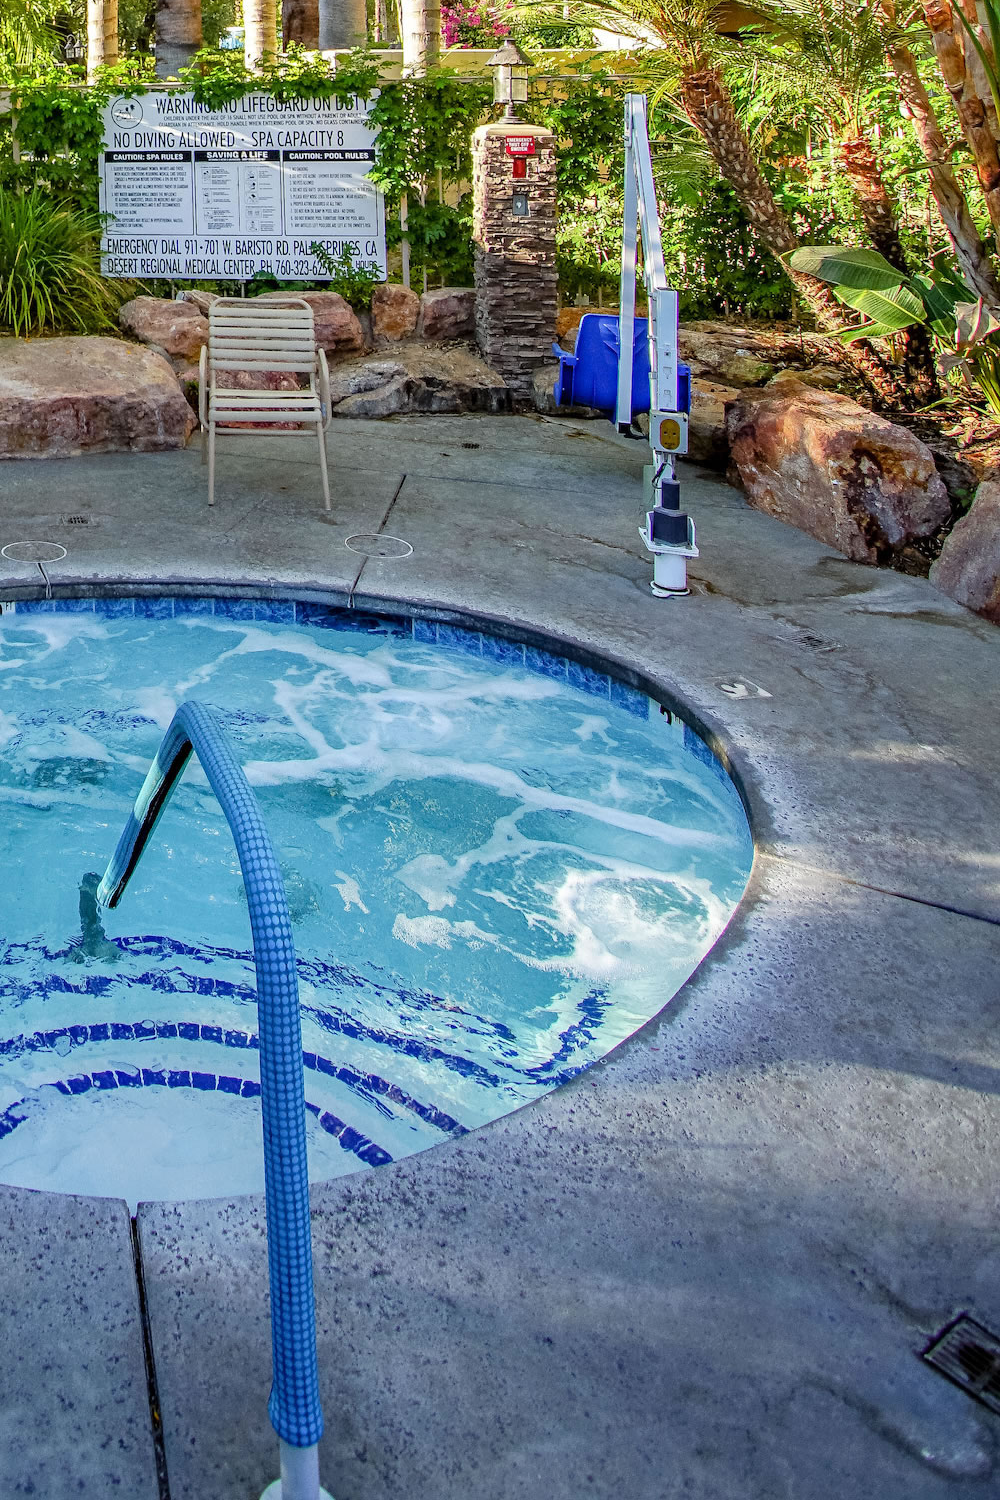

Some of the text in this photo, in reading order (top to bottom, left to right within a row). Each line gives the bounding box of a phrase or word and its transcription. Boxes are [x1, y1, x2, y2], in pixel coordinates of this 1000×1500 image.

[156, 95, 369, 114] WARNING NO LIFEGUARD ON DUTY
[114, 131, 235, 148] NO DIVING ALLOWED
[251, 130, 344, 147] SPA CAPACITY 8
[206, 151, 239, 159] SAVING
[107, 239, 198, 255] EMERGENCY DIAL 911
[205, 240, 219, 255] 701
[223, 240, 233, 255] W.
[235, 240, 273, 256] BARISTO
[276, 240, 291, 256] RD.
[366, 241, 378, 256] CA
[108, 259, 138, 274] DESERT
[141, 259, 182, 274] REGIONAL
[185, 259, 221, 275] MEDICAL
[223, 260, 255, 275] CENTER
[260, 260, 273, 274] PH
[276, 260, 334, 276] 760-323-625
